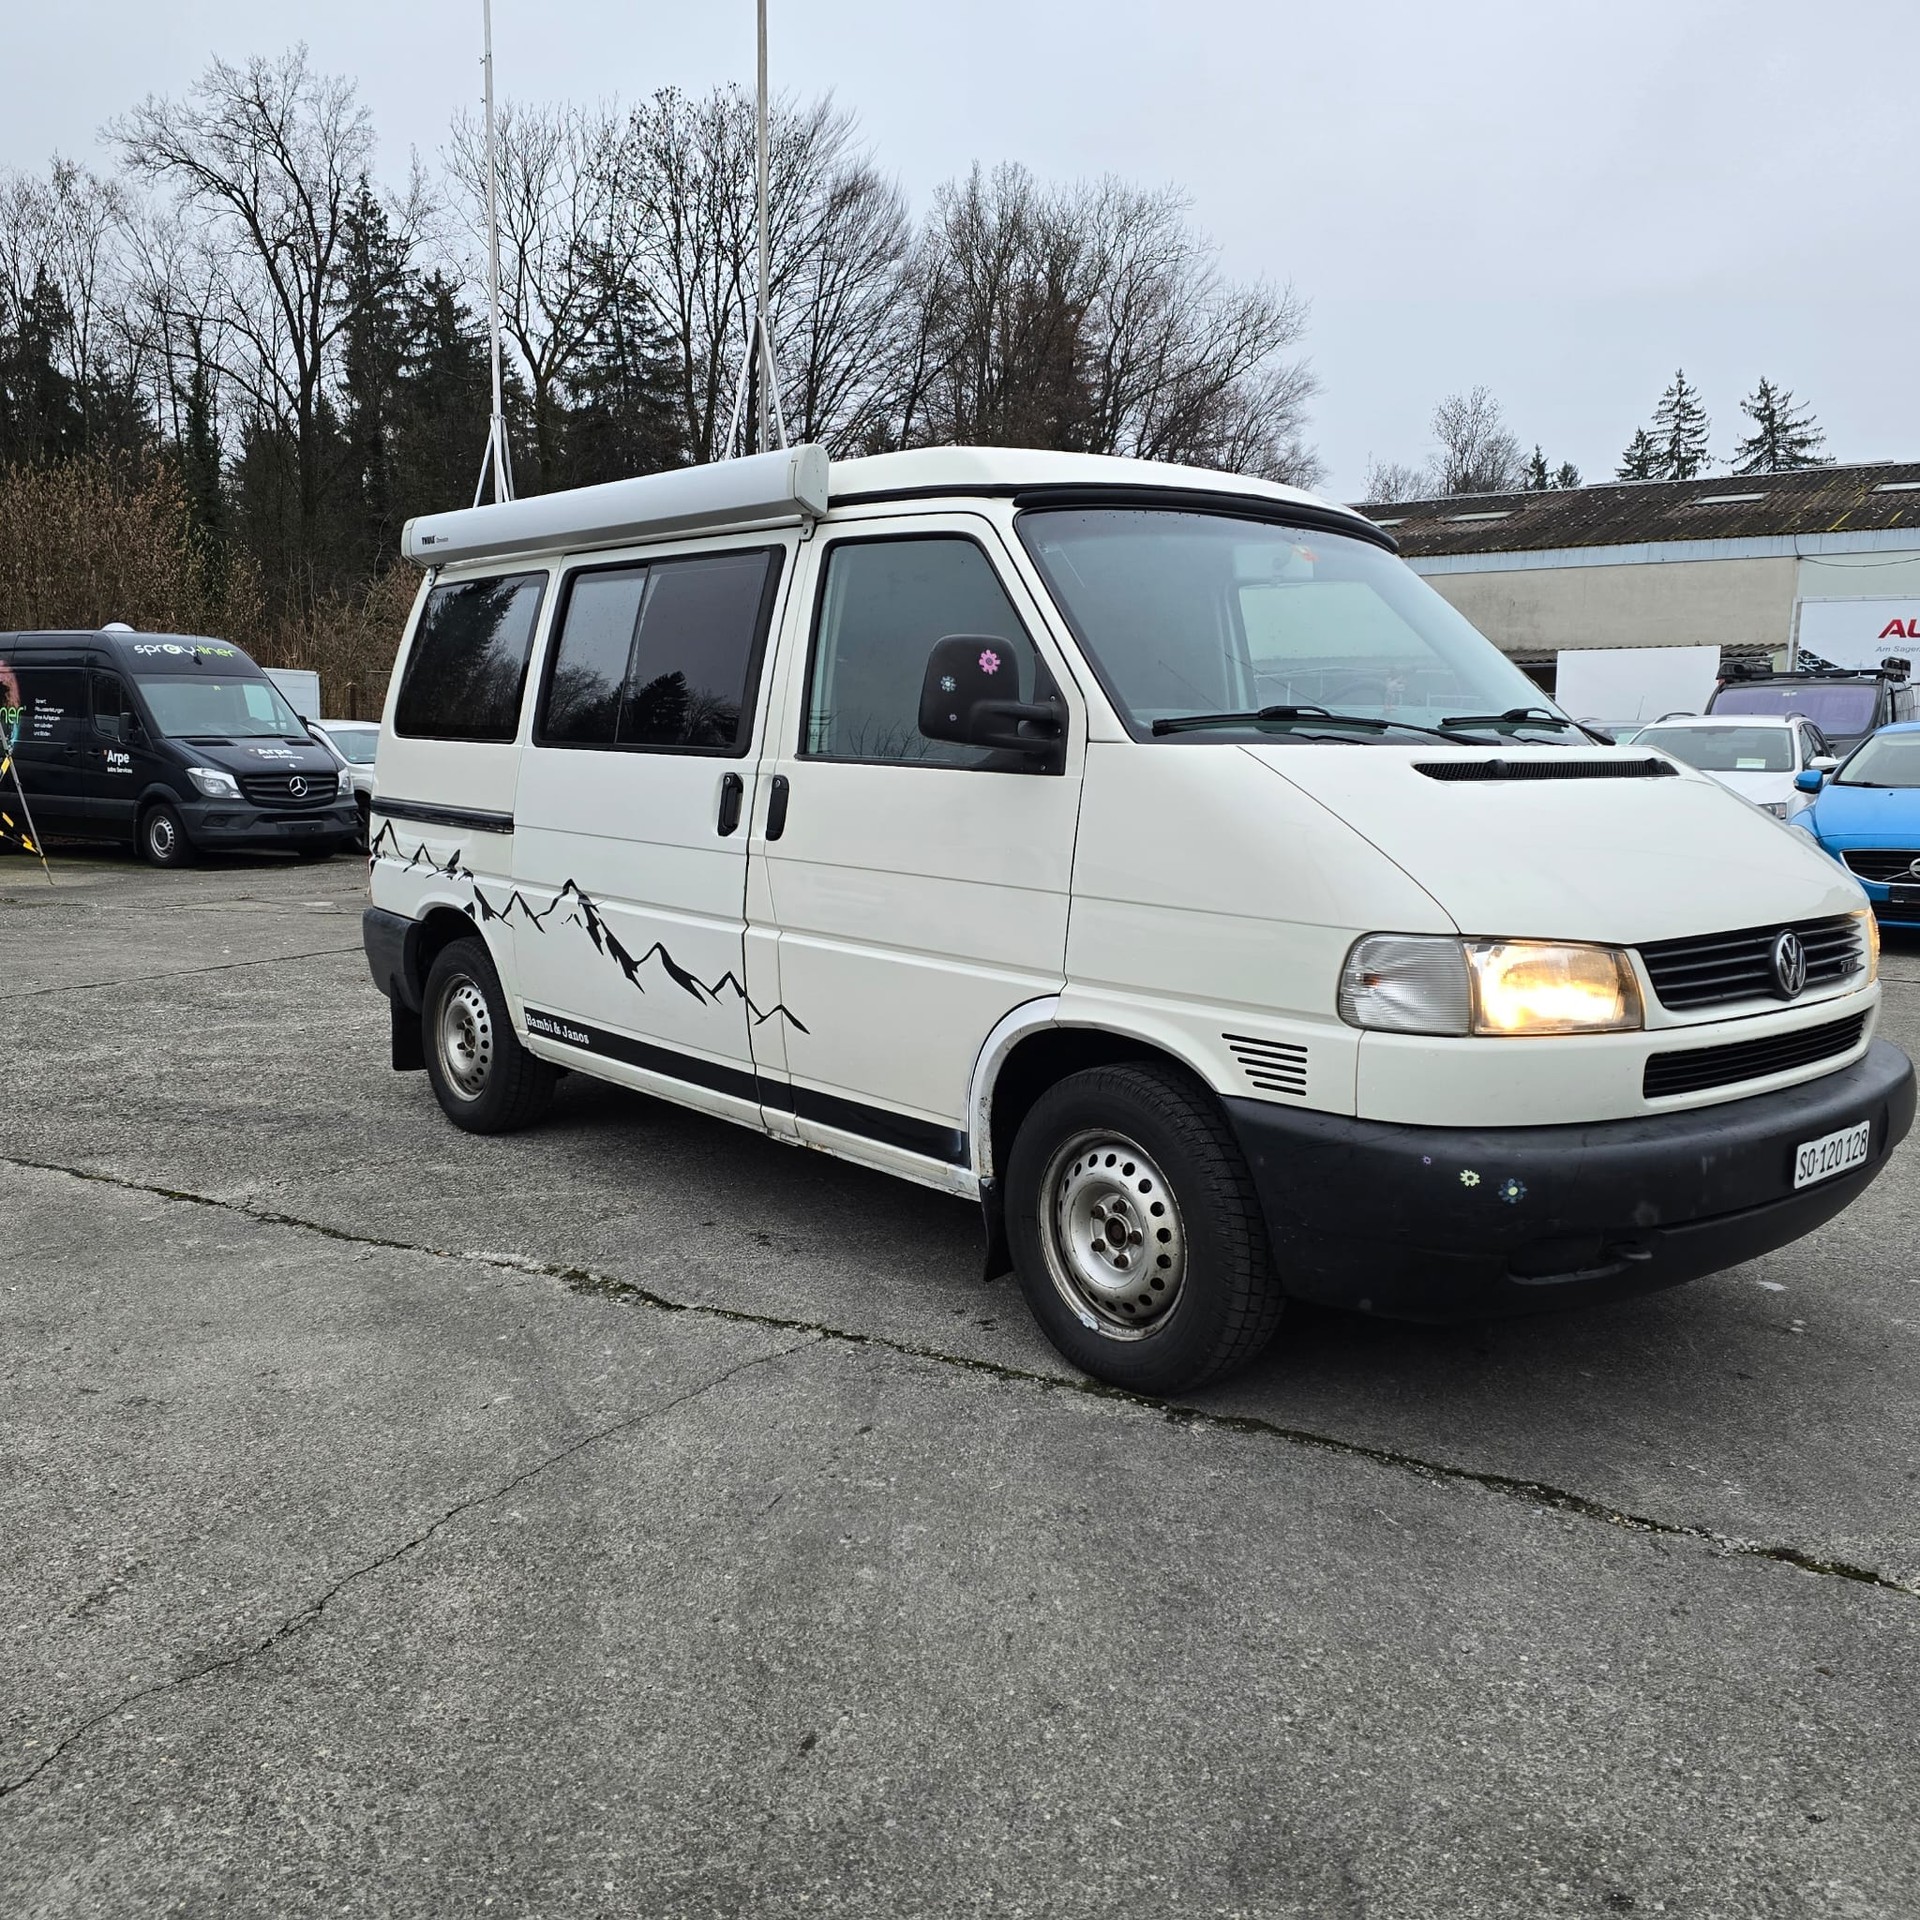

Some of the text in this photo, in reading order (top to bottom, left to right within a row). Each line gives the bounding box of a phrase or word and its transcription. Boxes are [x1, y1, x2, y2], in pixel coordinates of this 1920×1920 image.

[1893, 645, 1920, 653] Sager
[106, 749, 130, 766] Arpe
[526, 1014, 589, 1044] Bambi & Janos
[1845, 1128, 1868, 1163] 128
